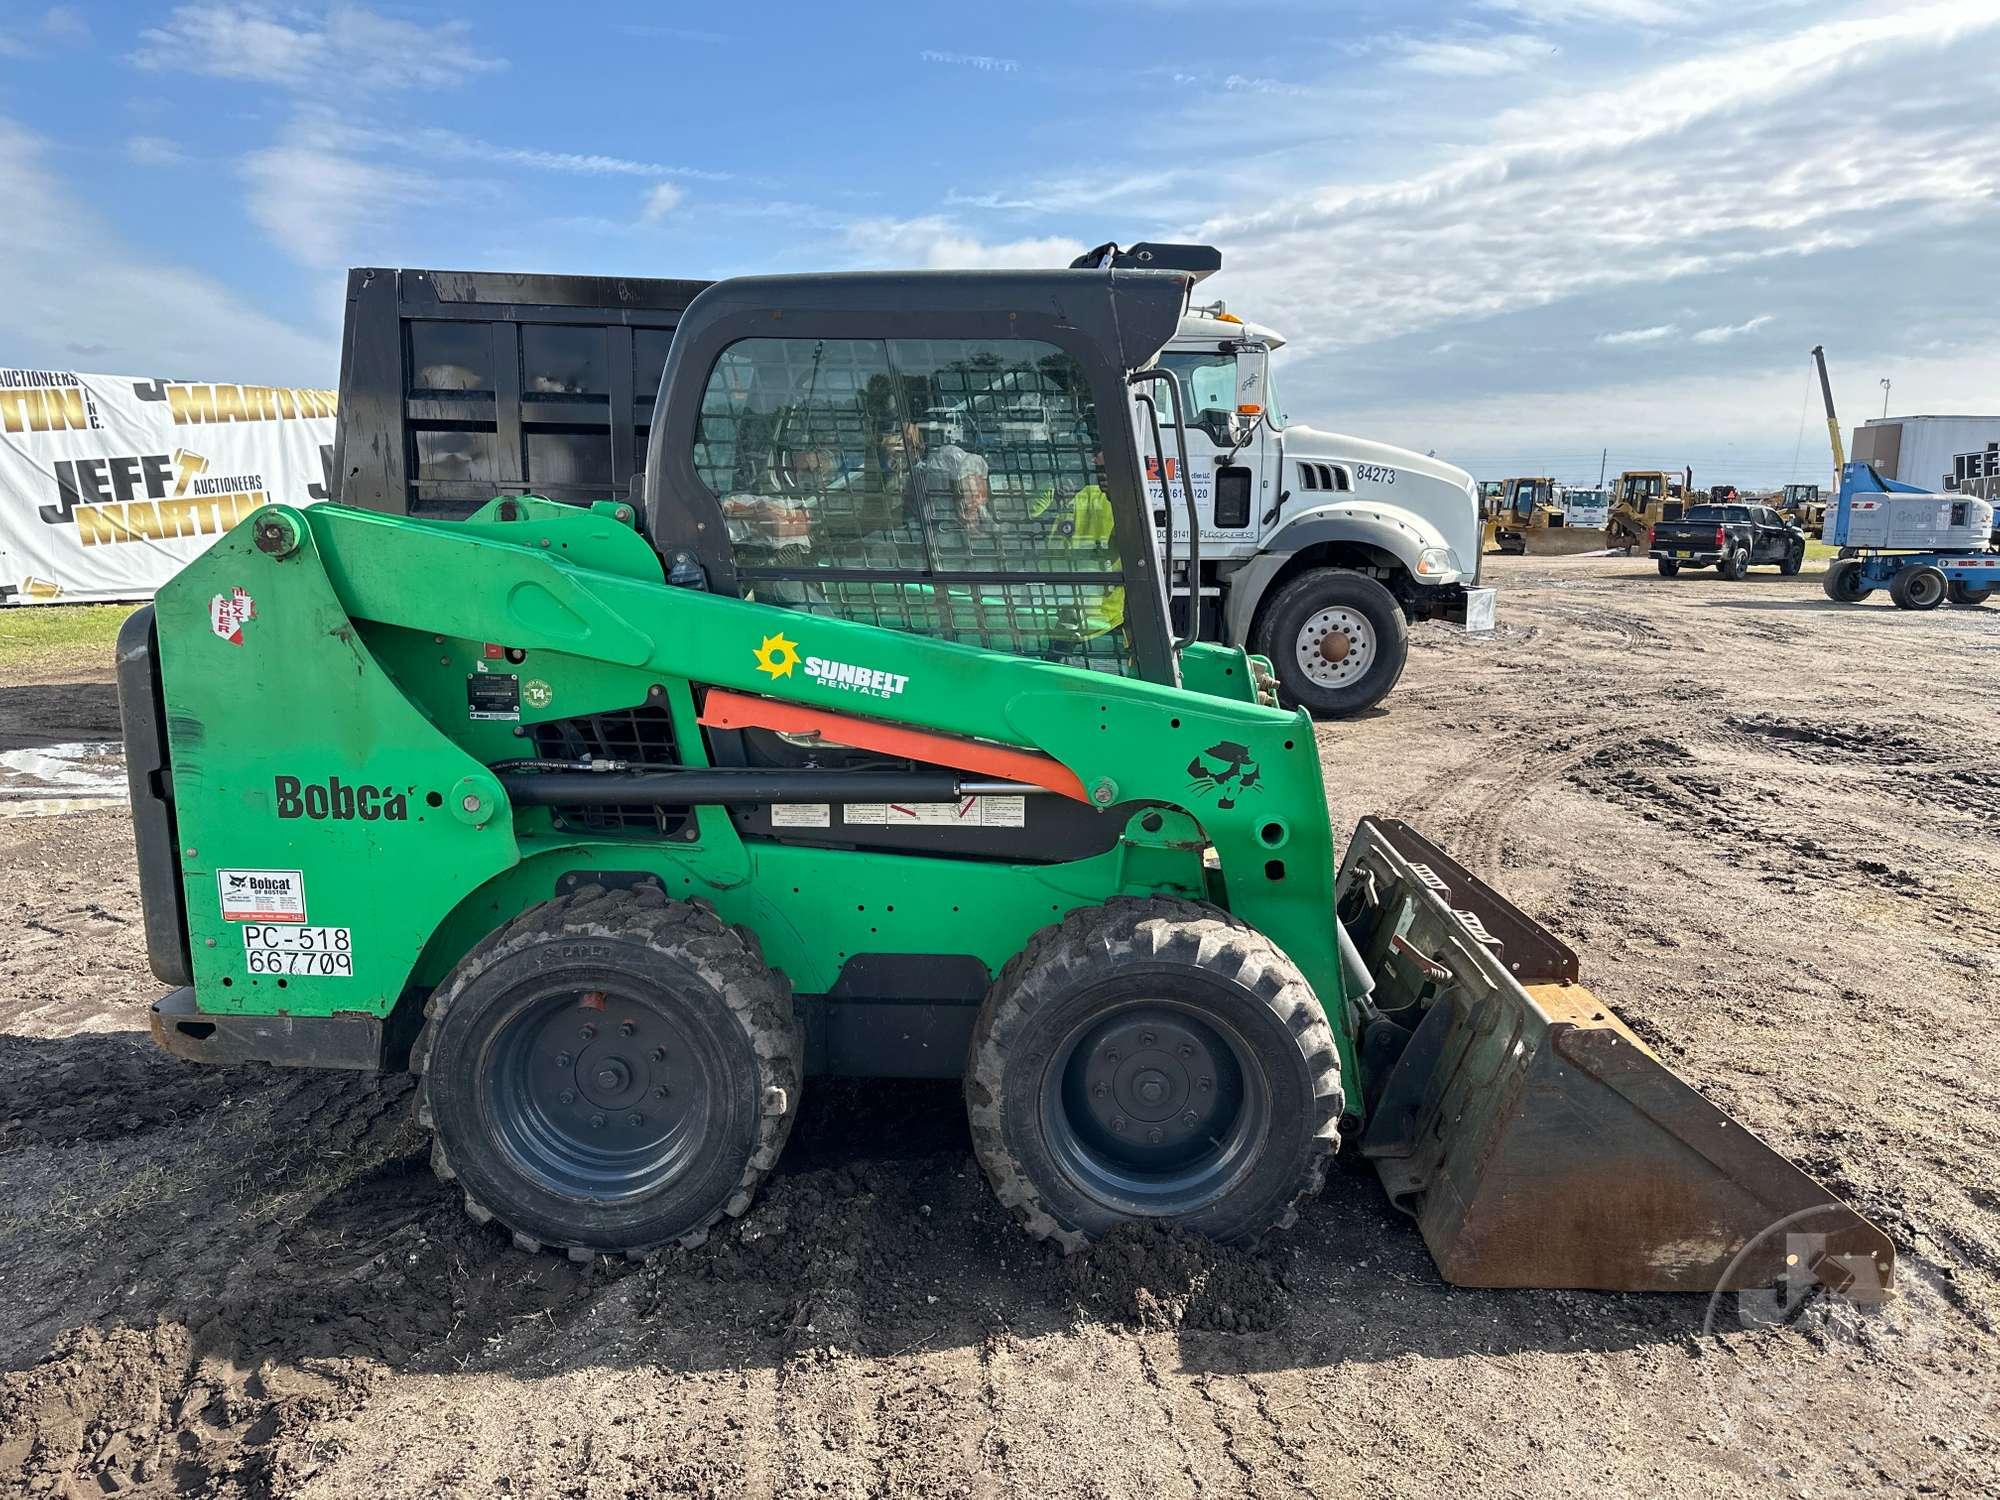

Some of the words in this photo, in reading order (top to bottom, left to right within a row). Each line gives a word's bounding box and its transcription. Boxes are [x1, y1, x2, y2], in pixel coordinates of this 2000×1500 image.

[193, 474, 263, 496] AUCTIONEERS
[1356, 464, 1396, 485] 84273
[39, 454, 174, 525] JEFF
[75, 492, 265, 548] MARTIN
[804, 656, 909, 694] SUNBELT
[816, 678, 891, 699] RENTALS
[274, 775, 424, 821] Bobca
[249, 877, 291, 890] Bobcat
[245, 926, 350, 951] PC-518
[249, 951, 353, 975] 667709
